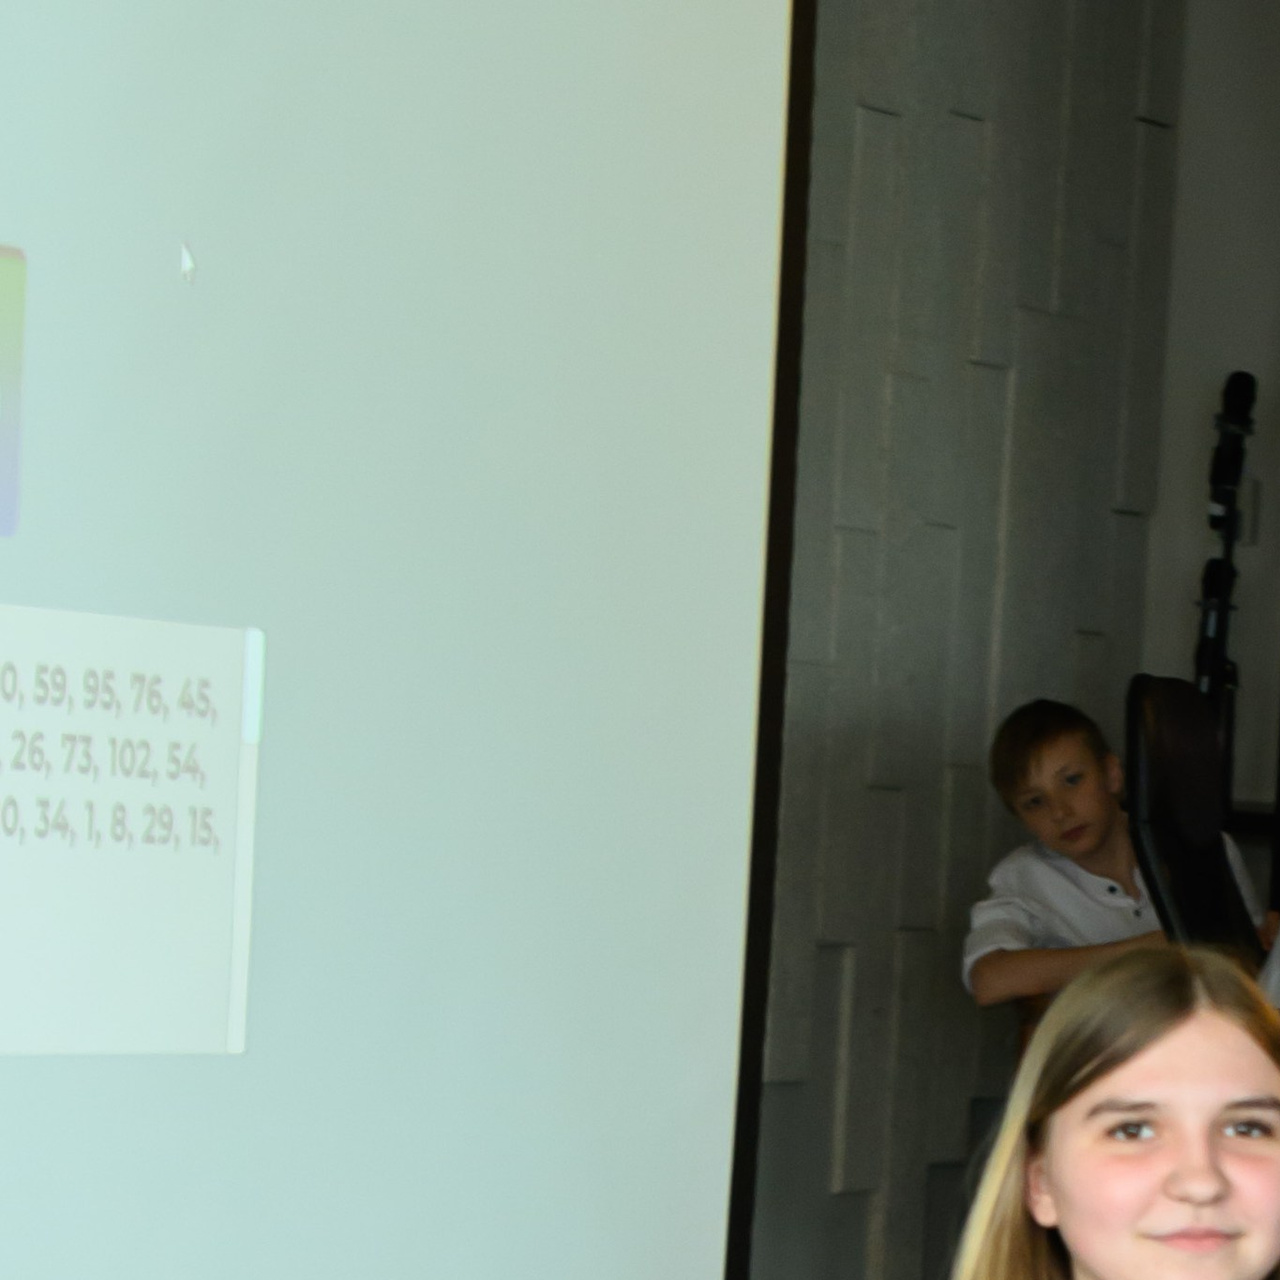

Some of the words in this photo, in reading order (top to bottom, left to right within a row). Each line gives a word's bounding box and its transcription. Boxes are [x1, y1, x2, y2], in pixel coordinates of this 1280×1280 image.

[33, 662, 73, 715] 59,
[82, 667, 122, 719] 95,
[130, 671, 169, 722] 76,
[177, 676, 218, 727] 45,
[10, 729, 51, 780] 26,
[61, 733, 99, 783] 73,
[108, 736, 158, 786] 102,
[166, 741, 206, 789] 54,
[34, 796, 76, 847] 34,
[85, 800, 101, 848] 1,
[110, 801, 133, 850] 8,
[141, 803, 180, 852] 29,
[188, 805, 219, 854] 15,
